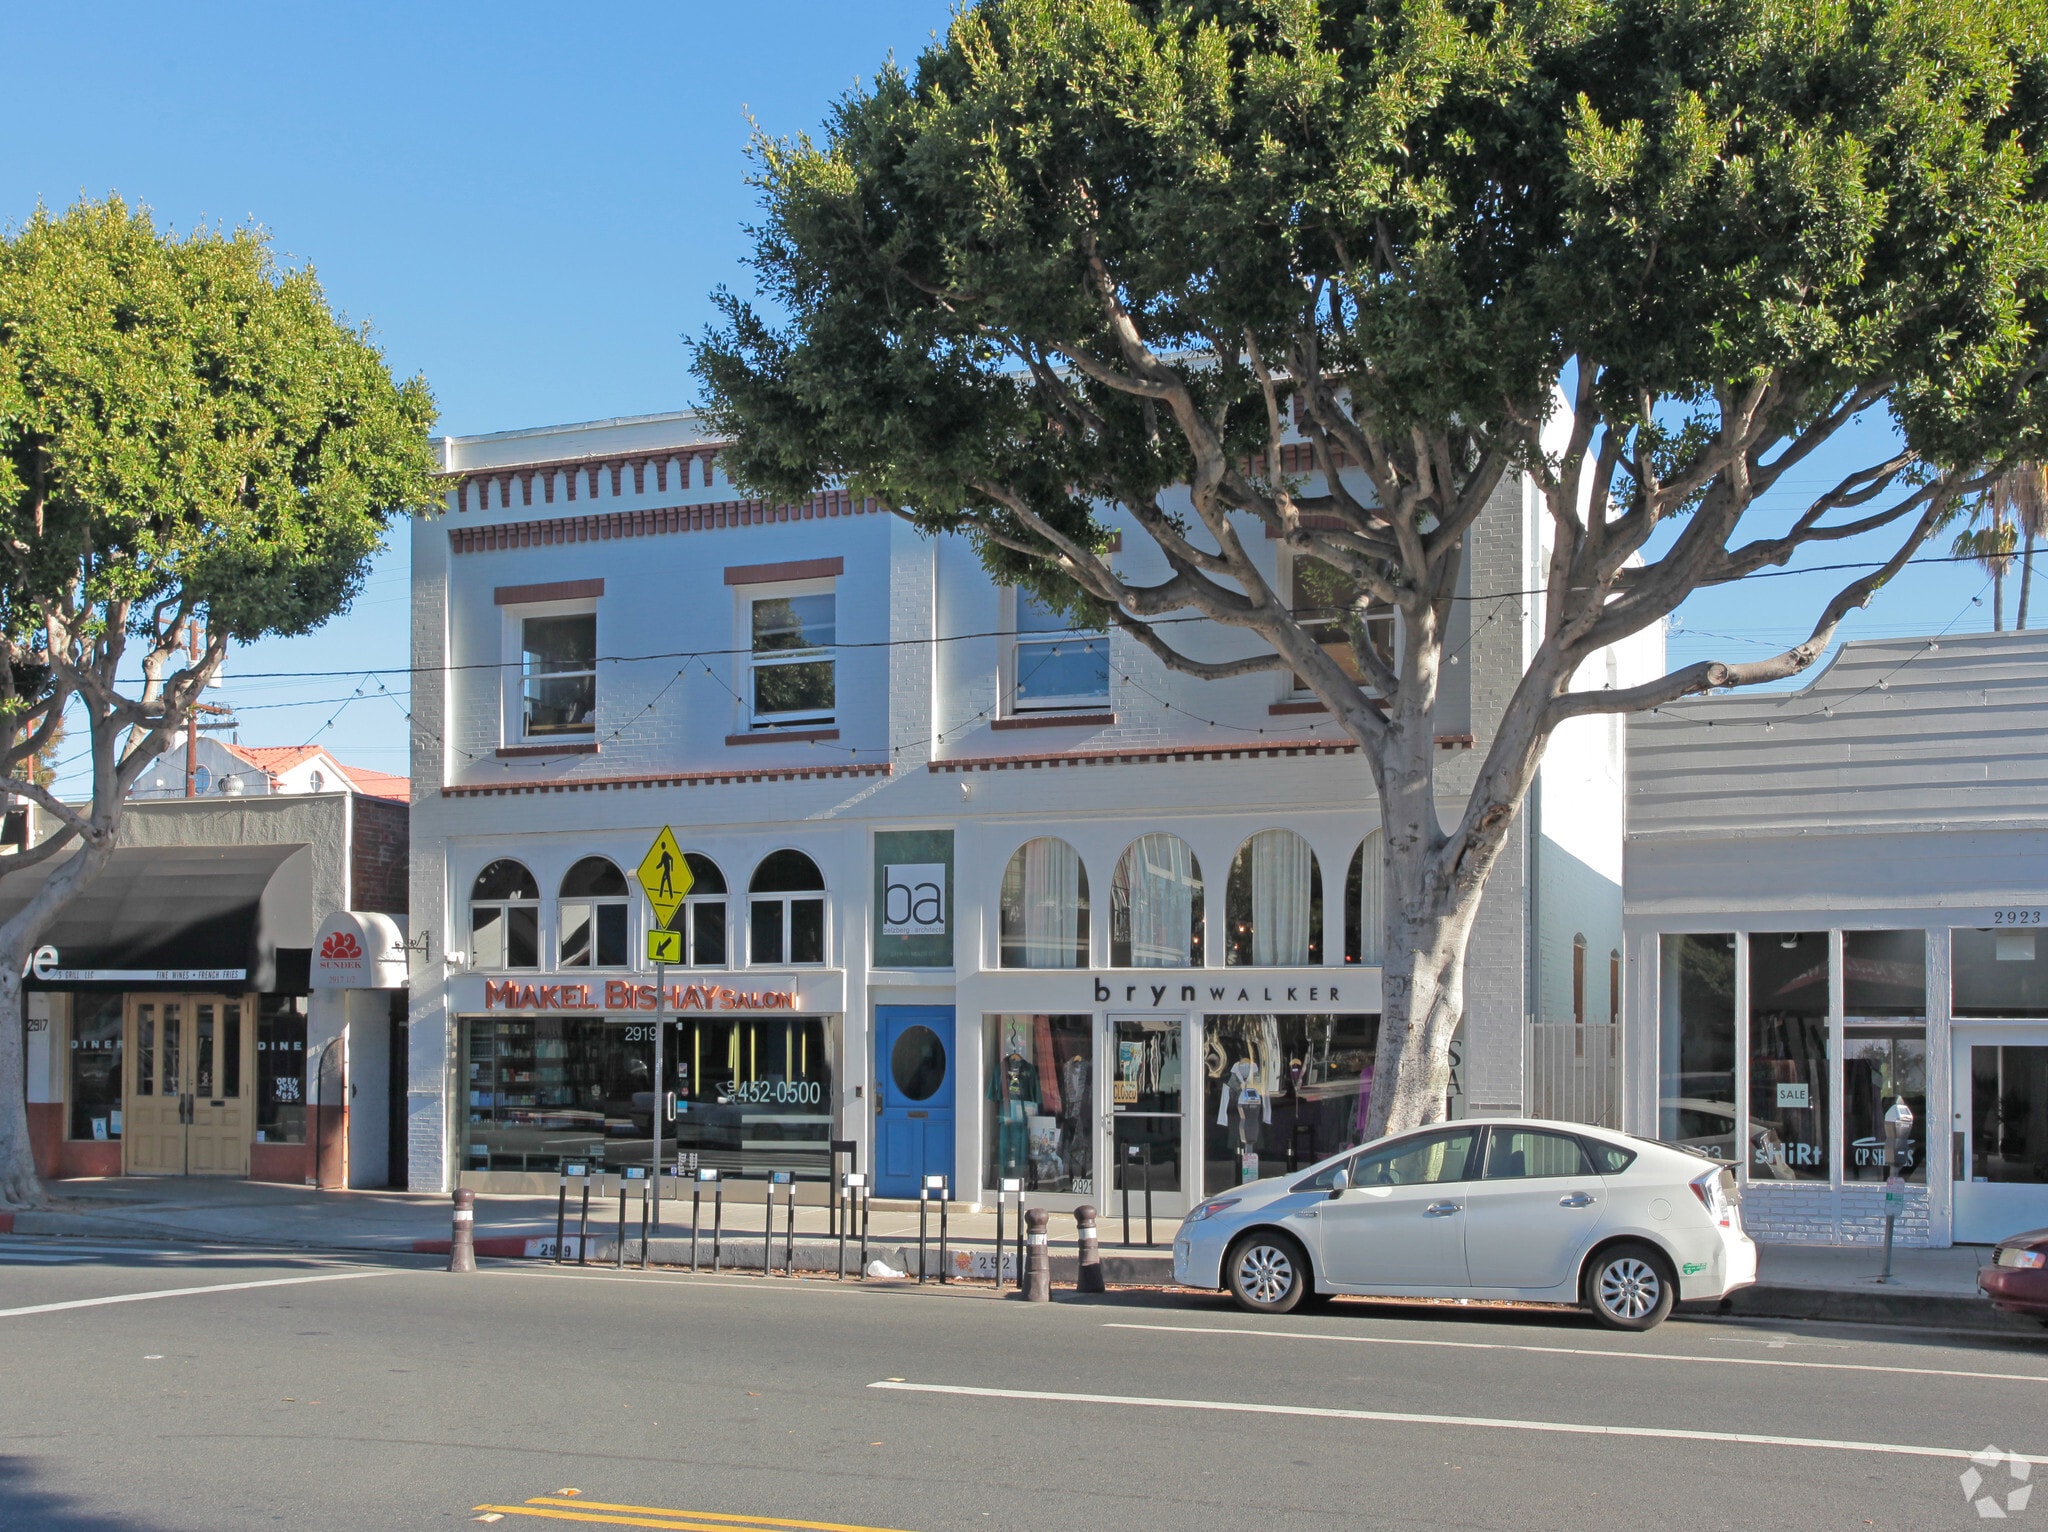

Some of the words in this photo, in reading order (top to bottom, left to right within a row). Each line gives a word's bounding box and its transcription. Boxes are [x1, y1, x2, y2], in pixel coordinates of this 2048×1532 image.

[884, 866, 945, 925] ba
[1994, 911, 2040, 924] 2923
[914, 926, 945, 934] architects
[319, 961, 362, 969] SUNDEK
[156, 970, 168, 980] FINE
[172, 970, 189, 980] WINES
[198, 970, 220, 979] FRENCH
[222, 970, 239, 979] FRIES
[328, 975, 344, 984] 2917
[485, 980, 599, 1010] MIAKEL
[604, 980, 720, 1010] BISHAY
[719, 988, 797, 1010] SALON
[1094, 977, 1196, 1007] bryn
[1209, 987, 1340, 1001] WALKER
[27, 1018, 49, 1032] 2917
[625, 1026, 657, 1042] 2919
[257, 1041, 303, 1051] DINE
[276, 1077, 299, 1087] OPEN
[738, 1081, 821, 1104] 452-0500
[1780, 1090, 1806, 1099] SALE
[1855, 1148, 1870, 1166] CP
[1872, 1148, 1914, 1167] SHS
[540, 1243, 572, 1258] 299
